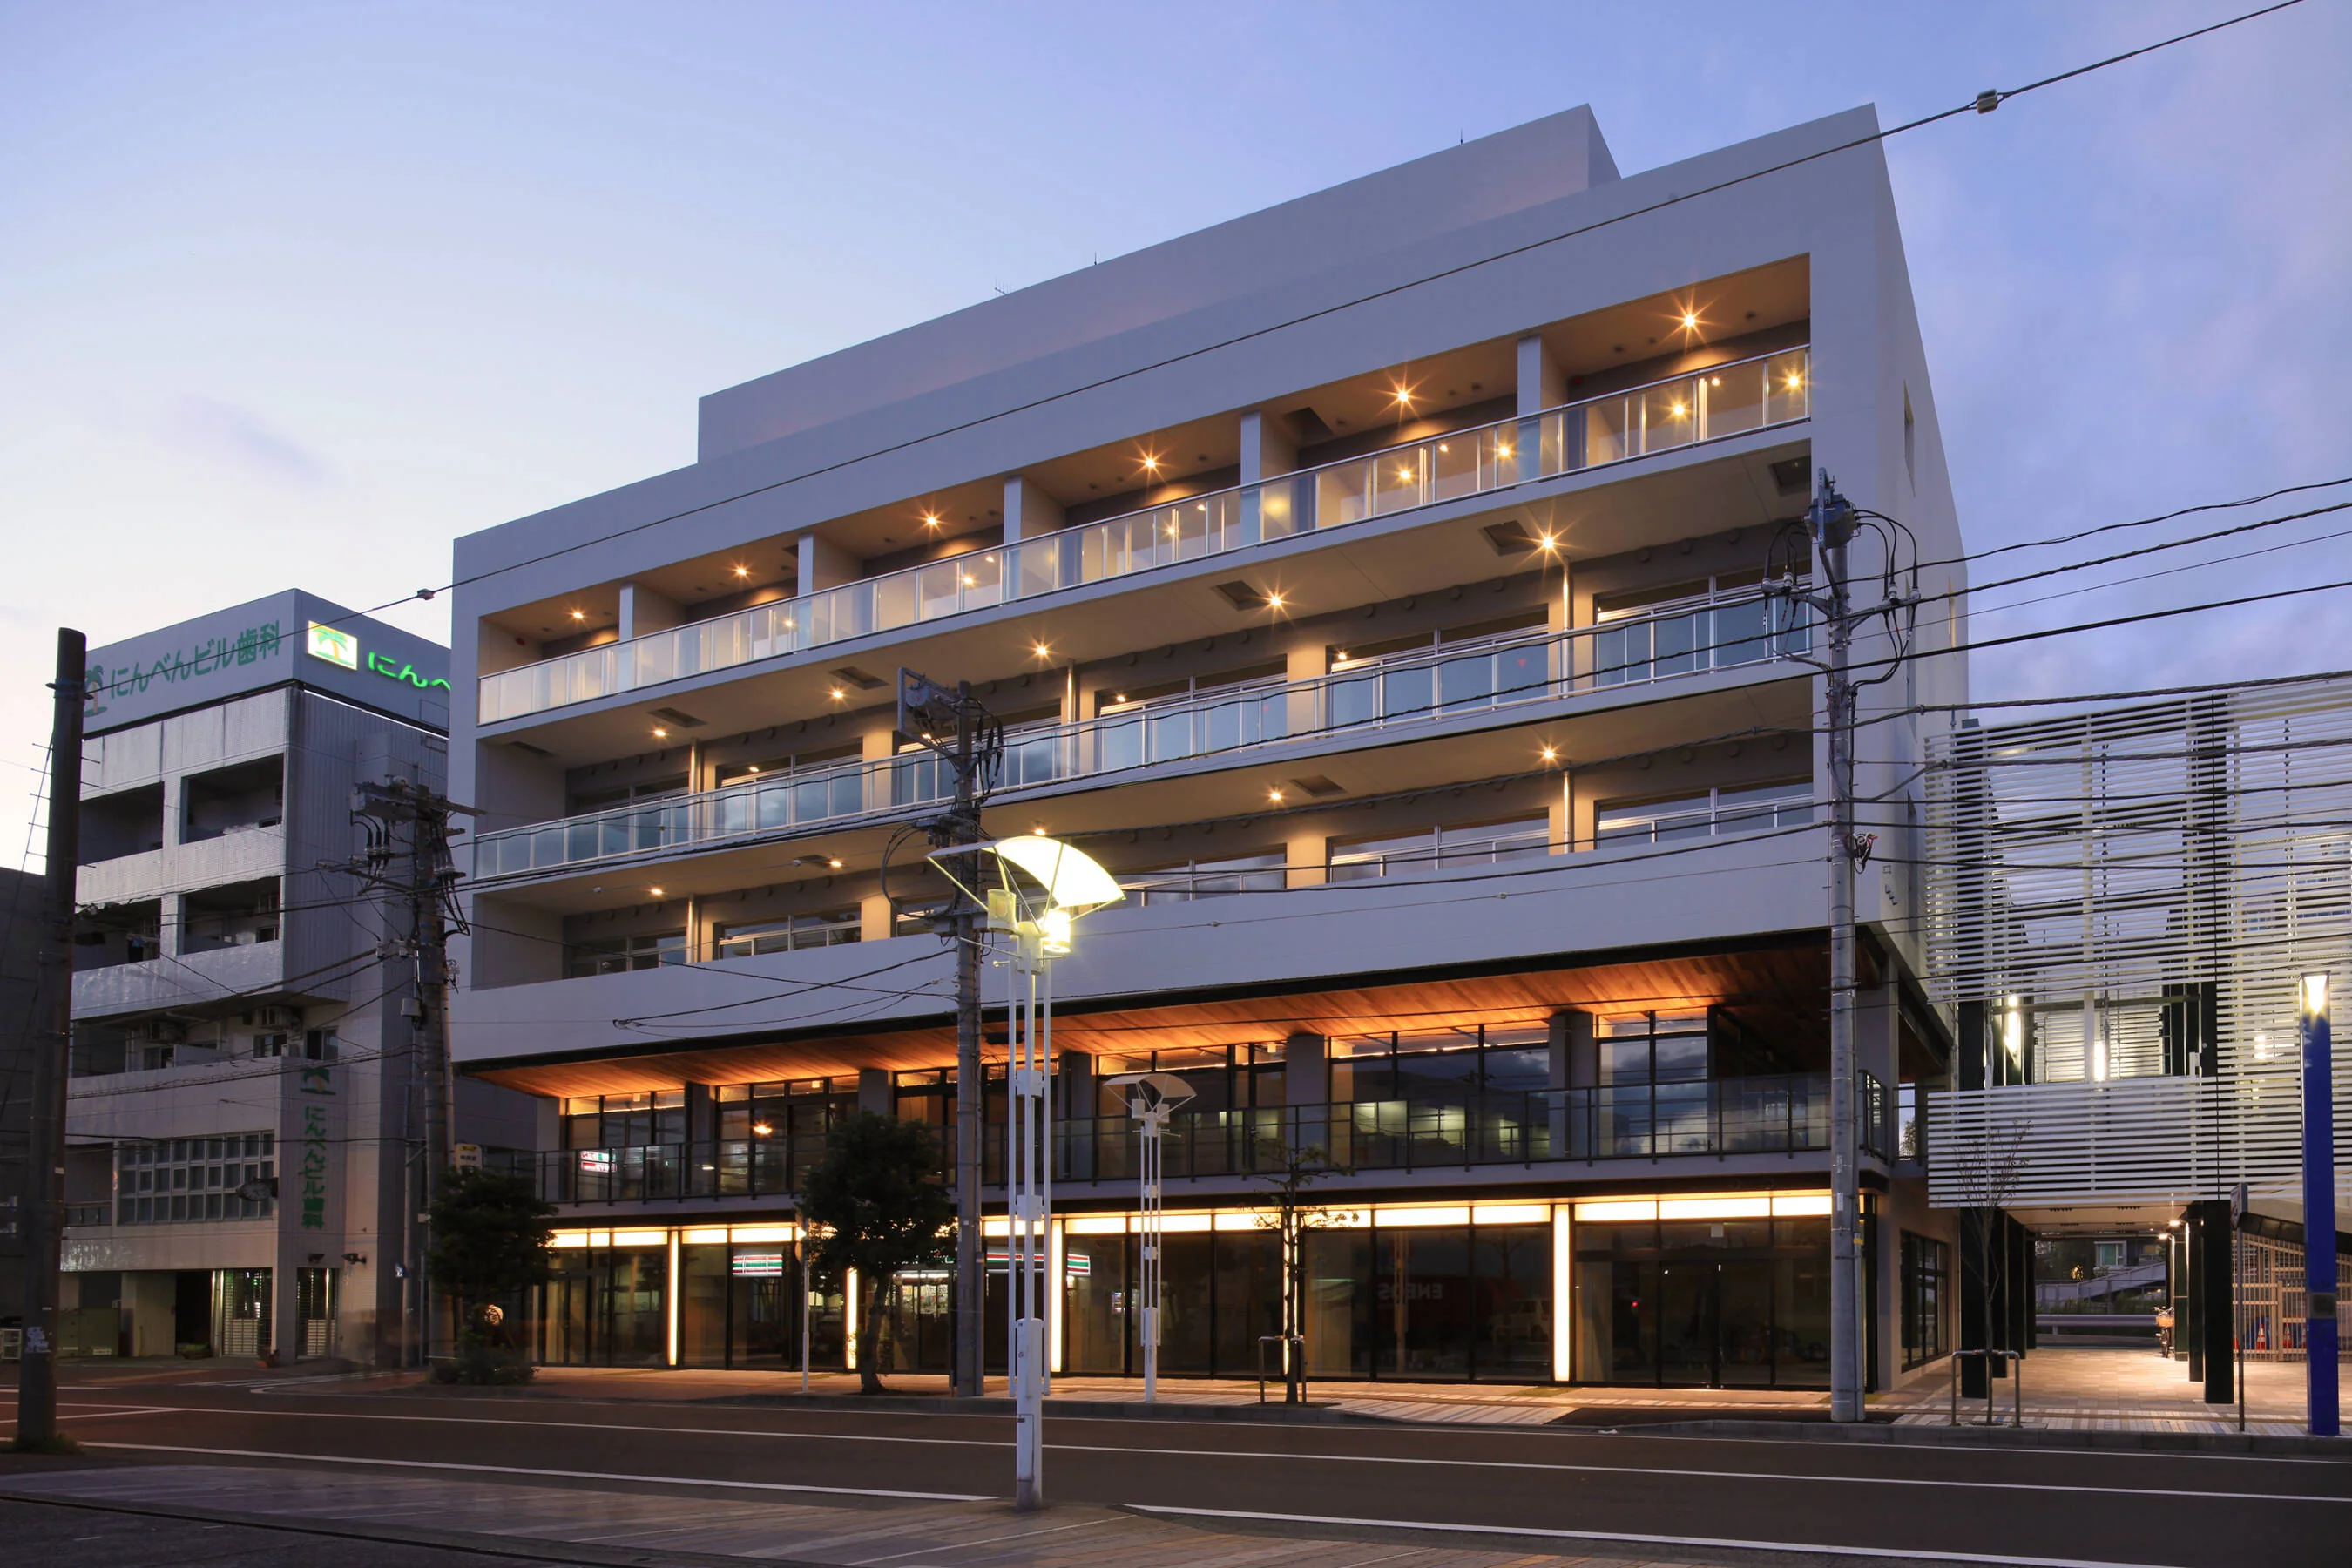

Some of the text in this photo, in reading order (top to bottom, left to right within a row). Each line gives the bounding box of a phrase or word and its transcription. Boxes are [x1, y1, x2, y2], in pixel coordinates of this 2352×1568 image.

[110, 619, 280, 699] にんべんビル歯科
